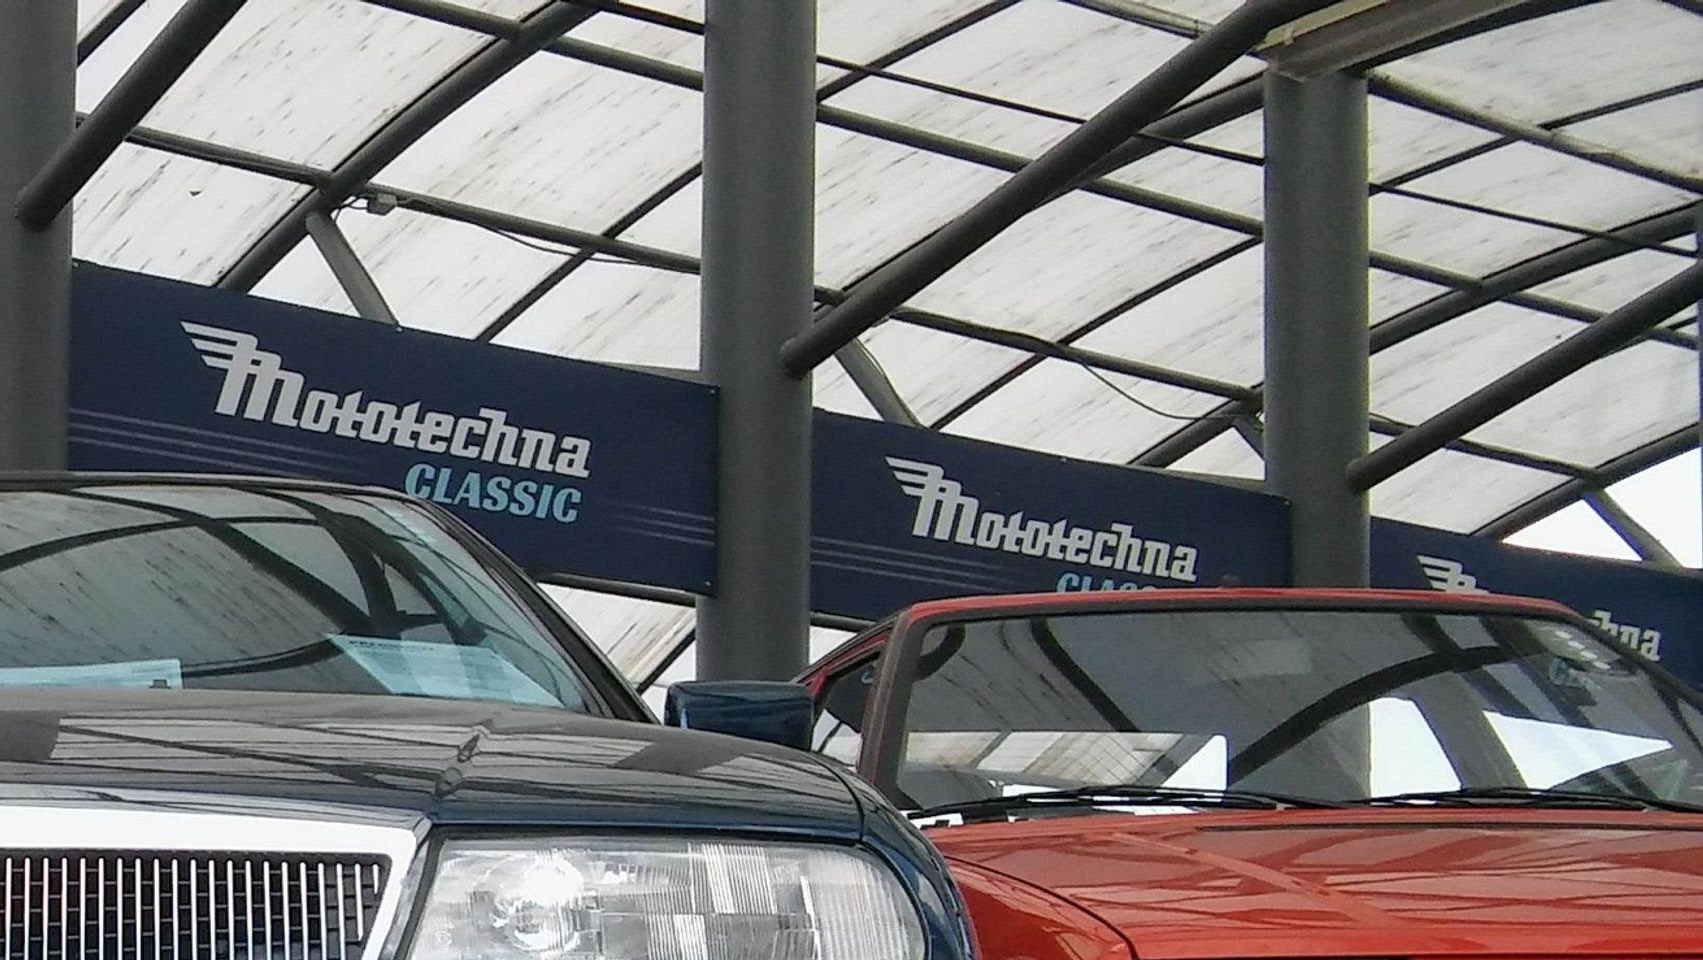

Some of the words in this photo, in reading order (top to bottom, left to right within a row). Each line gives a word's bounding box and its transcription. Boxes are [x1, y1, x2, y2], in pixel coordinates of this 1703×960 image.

[179, 321, 593, 479] Mototechna
[404, 463, 583, 523] CLASSIC
[884, 456, 1200, 583] Mototechna
